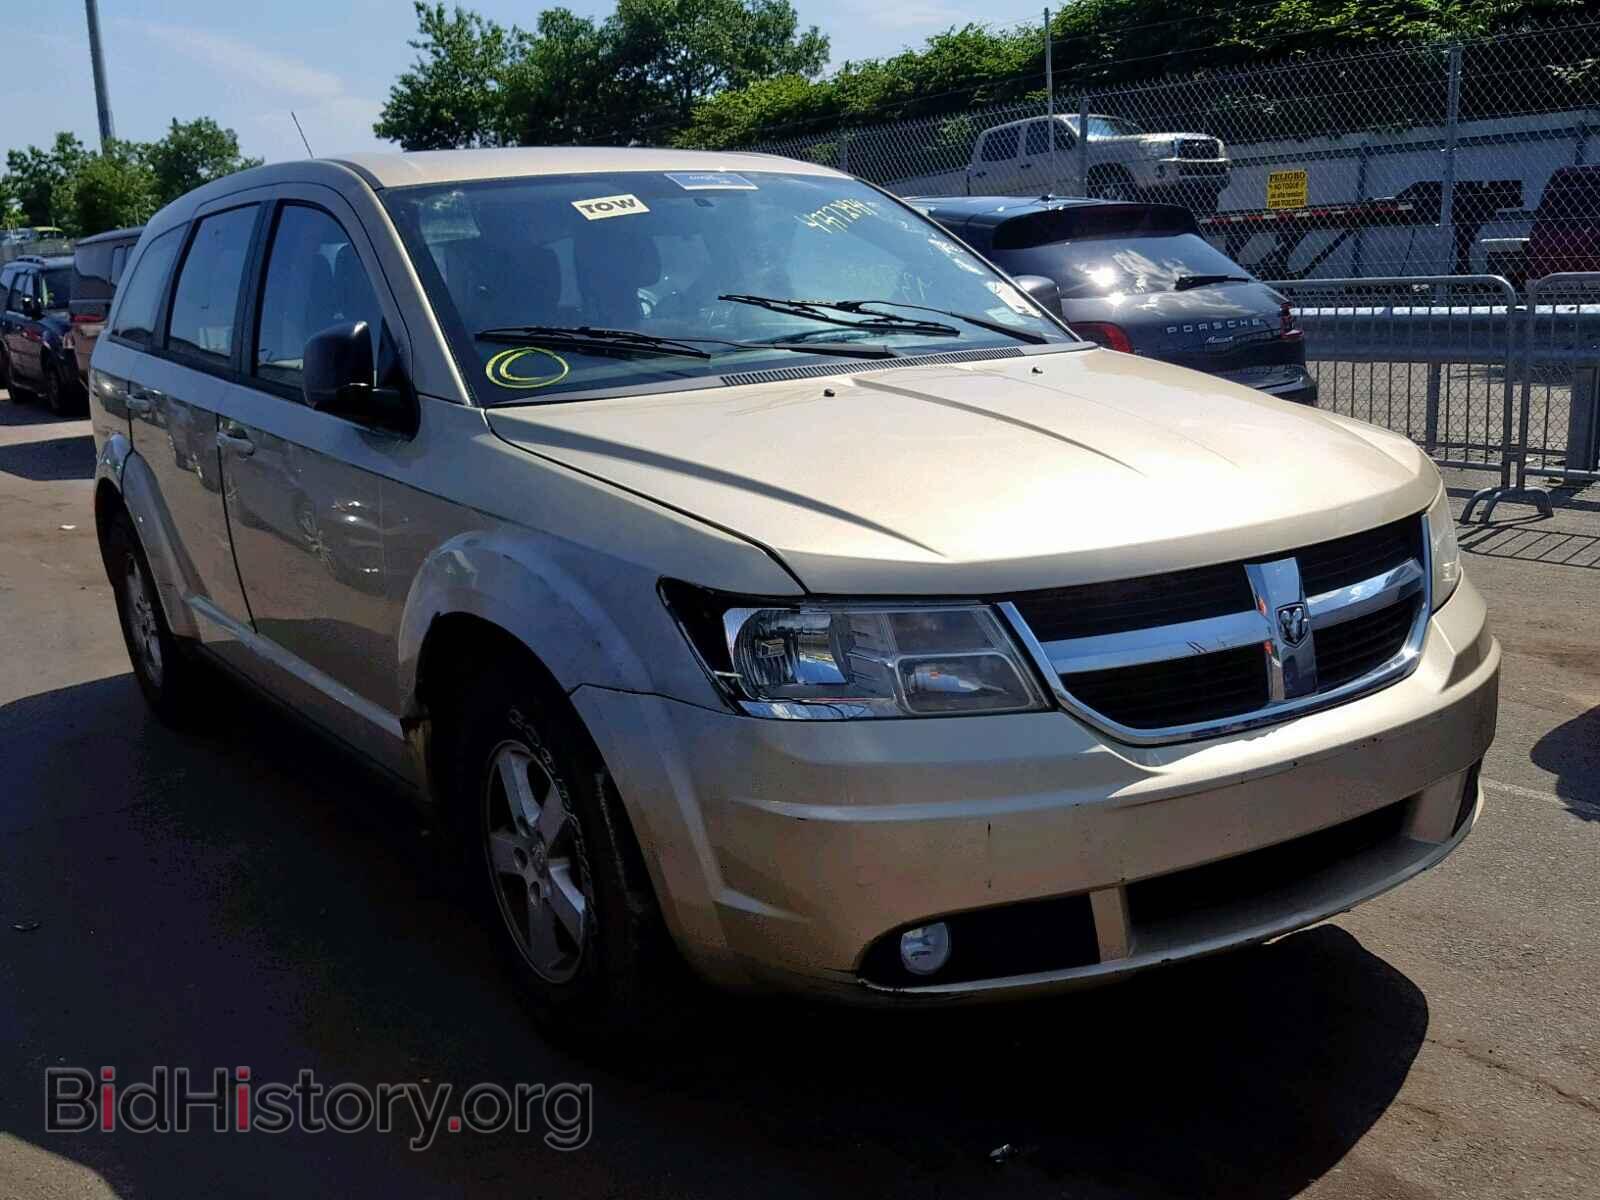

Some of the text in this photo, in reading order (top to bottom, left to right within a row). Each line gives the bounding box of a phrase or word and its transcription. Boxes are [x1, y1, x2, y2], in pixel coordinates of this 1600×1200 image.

[1270, 171, 1306, 182] PELIGRO
[579, 199, 636, 213] TOW
[1166, 318, 1262, 334] PORSCHE
